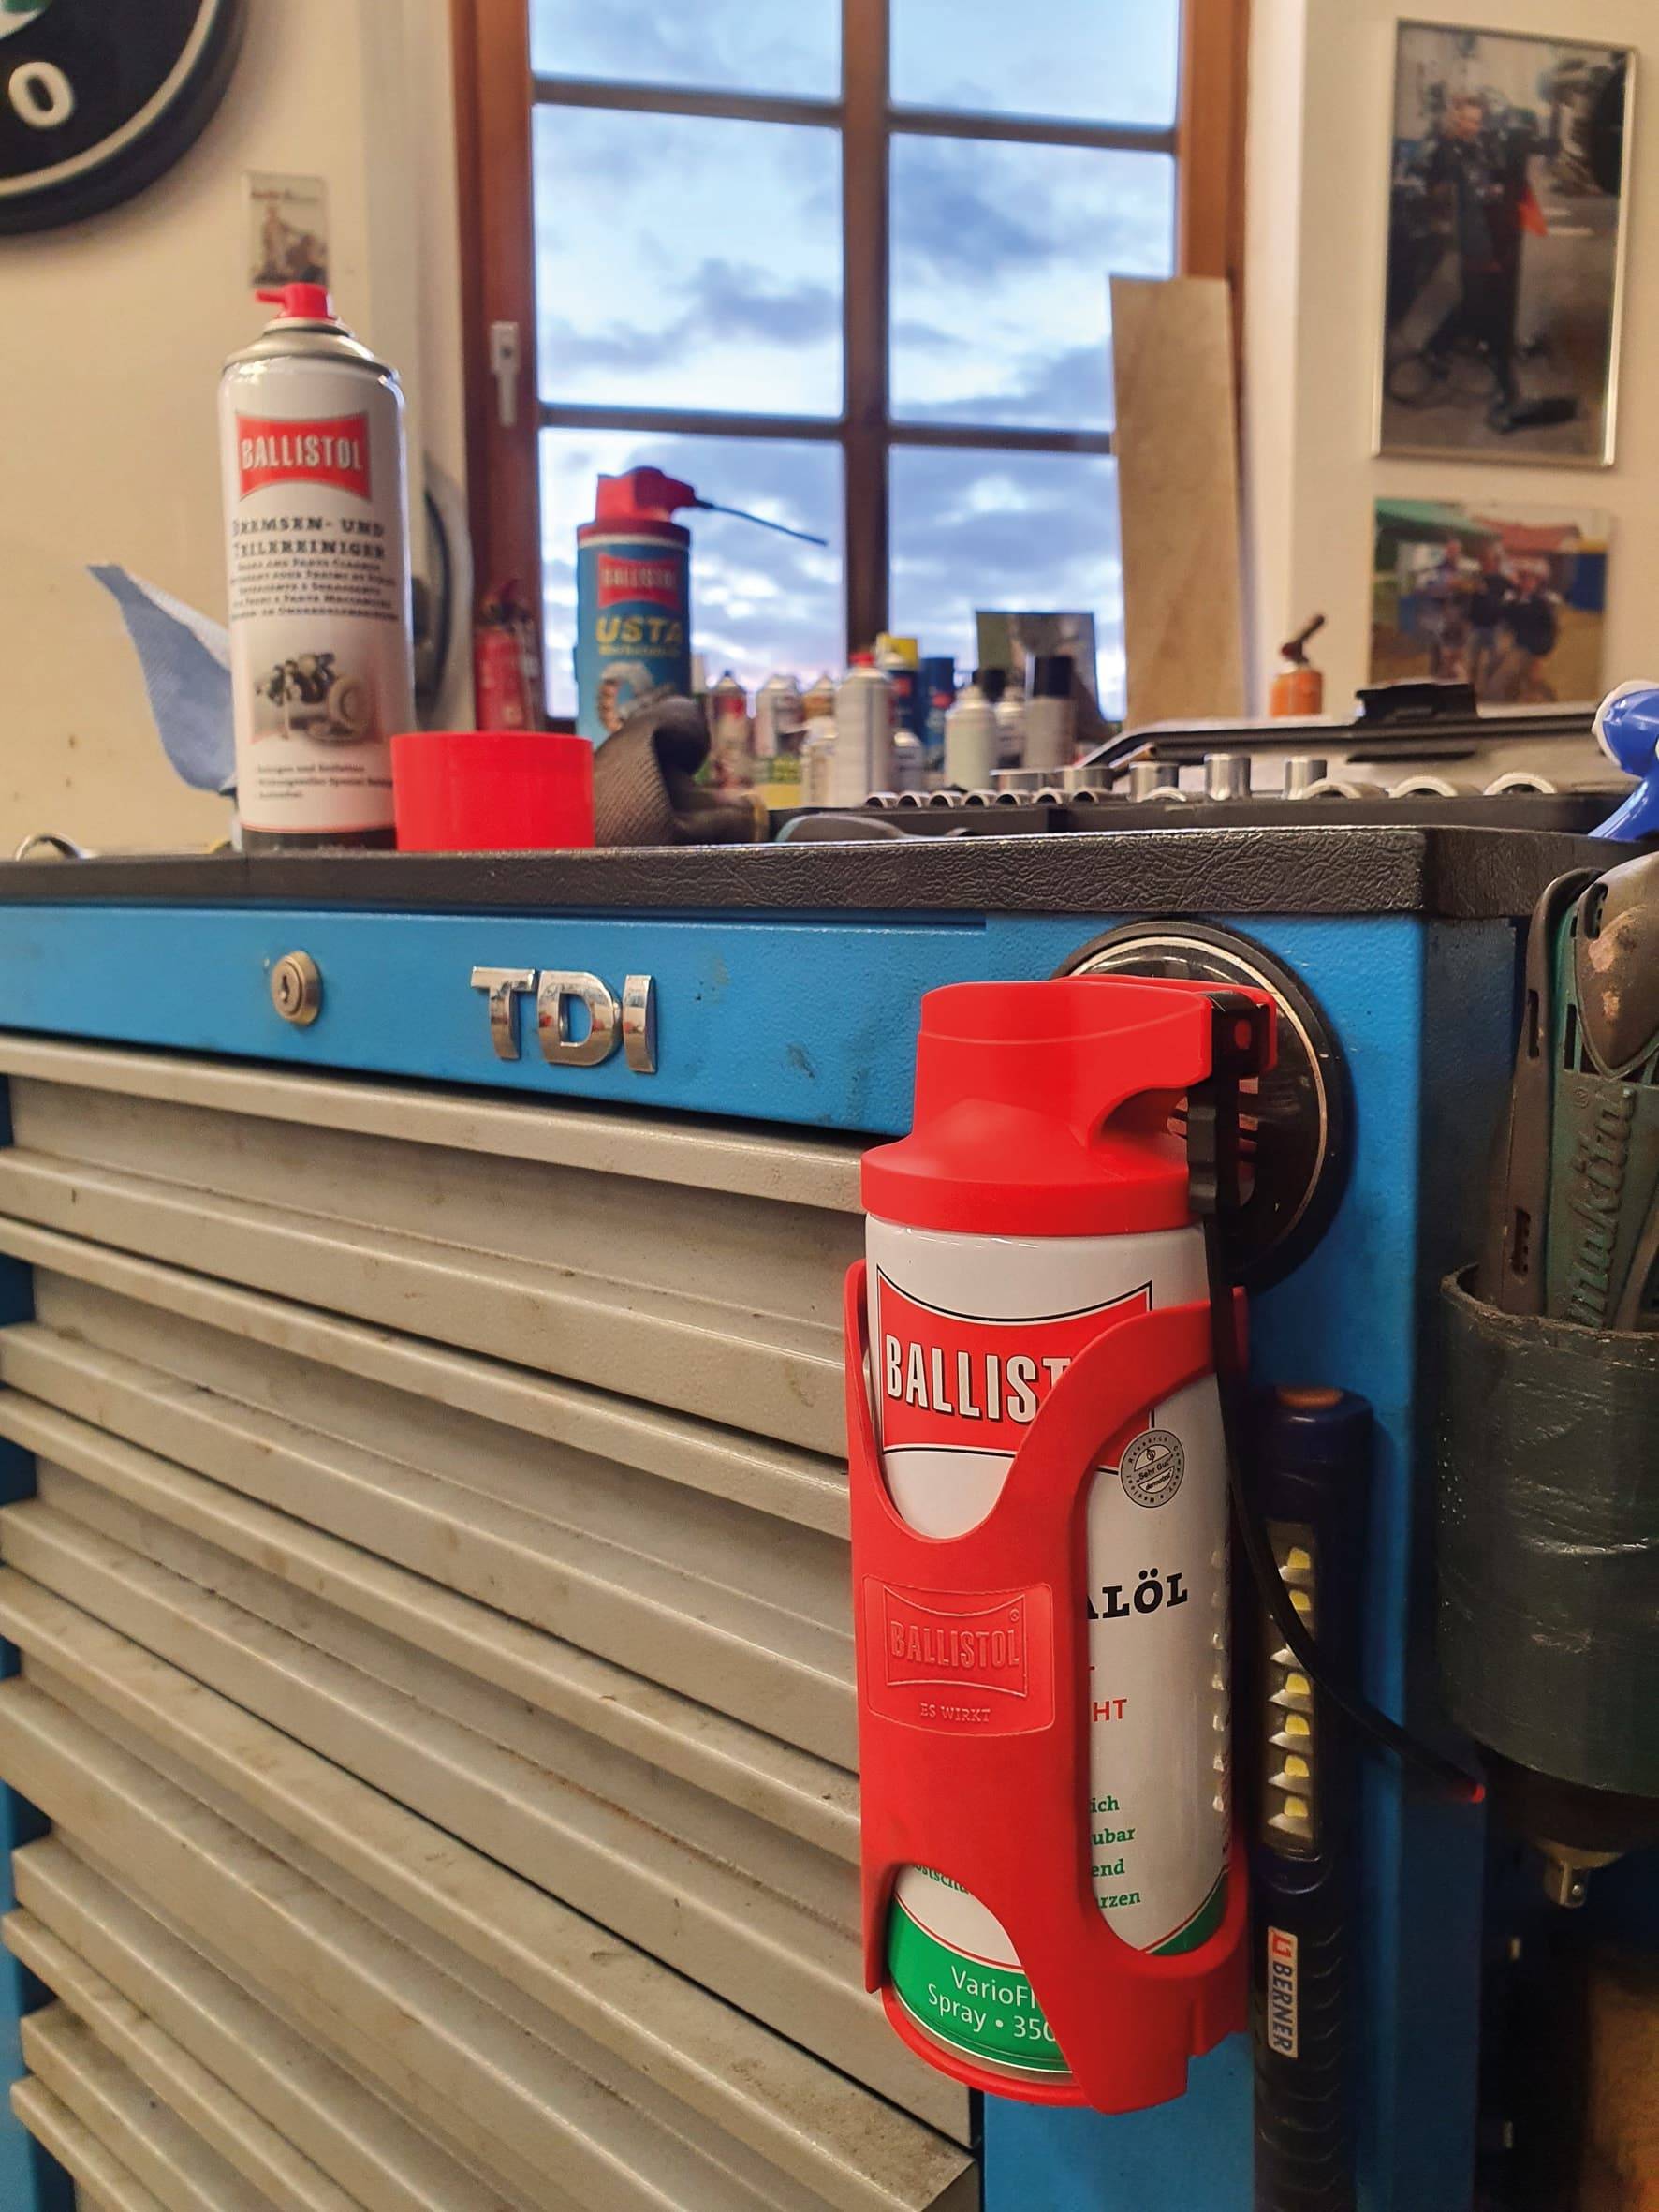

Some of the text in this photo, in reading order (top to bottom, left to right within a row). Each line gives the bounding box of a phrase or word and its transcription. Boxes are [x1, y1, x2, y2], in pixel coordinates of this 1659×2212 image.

[241, 434, 362, 471] BALLISTOL
[471, 966, 658, 1073] TDI
[890, 1620, 1020, 1668] BALLISTOL
[920, 1703, 991, 1722] ES WIRKT
[928, 1983, 987, 2032] Spray
[1272, 1961, 1293, 2052] BERNER
